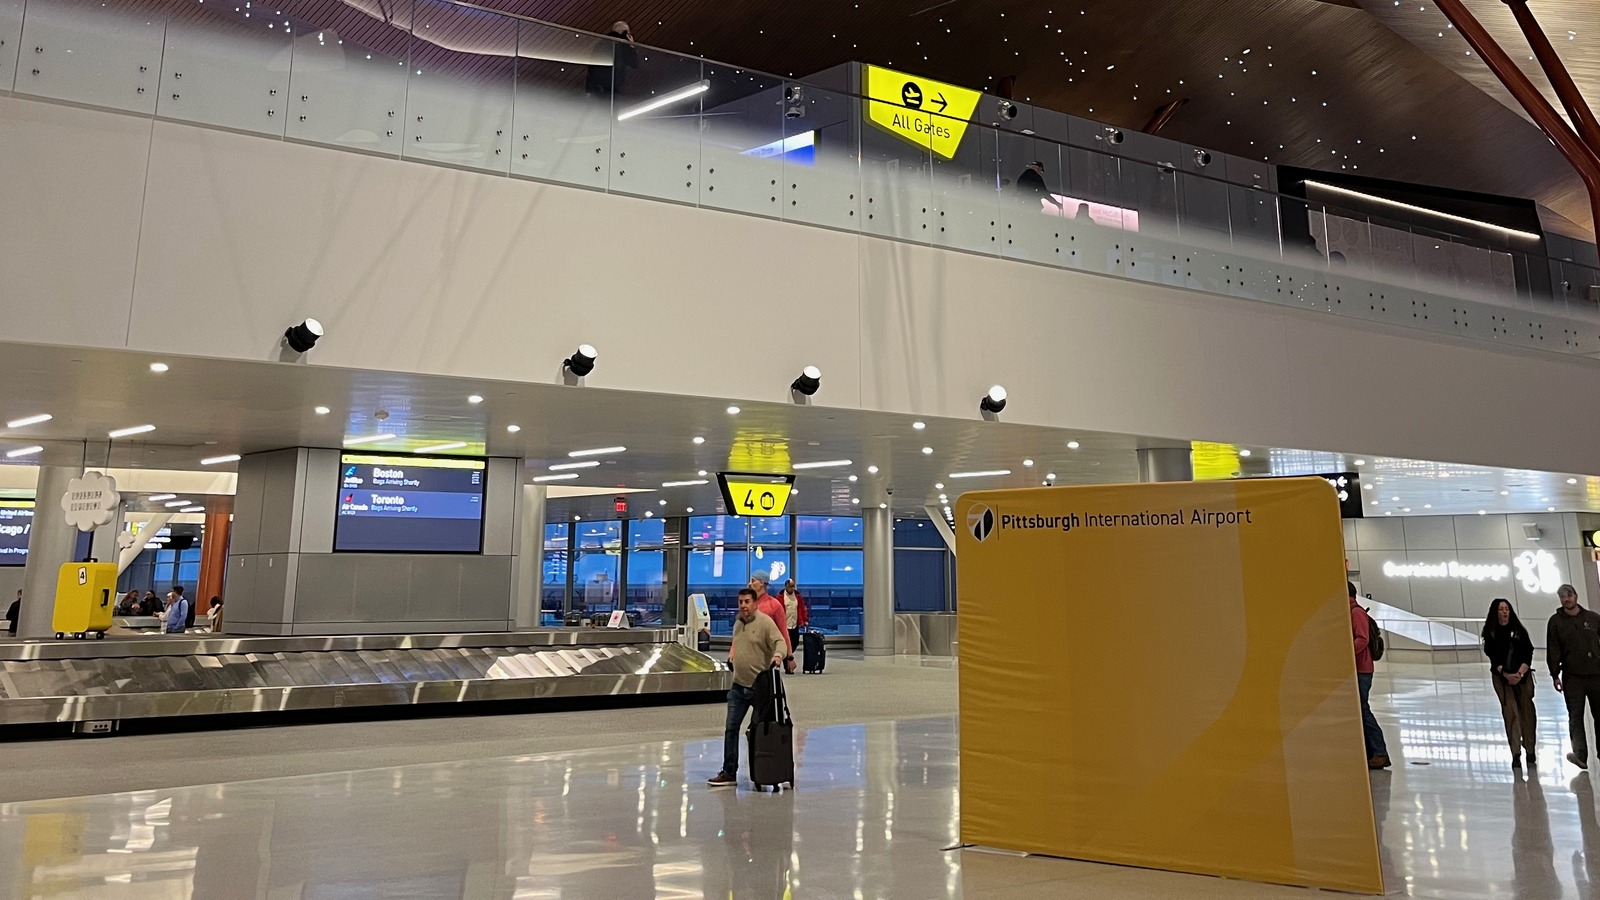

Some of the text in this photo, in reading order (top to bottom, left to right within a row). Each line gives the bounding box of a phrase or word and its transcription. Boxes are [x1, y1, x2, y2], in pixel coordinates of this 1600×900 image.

[892, 113, 951, 139] All Gates
[373, 467, 404, 478] Boston
[373, 478, 385, 486] Bags
[404, 479, 420, 487] Shortly
[371, 494, 405, 505] Toronto
[744, 489, 755, 510] 4
[384, 505, 401, 513] Arriving
[402, 505, 418, 513] Shortly
[1002, 508, 1252, 532] Pittsburgh International Airport
